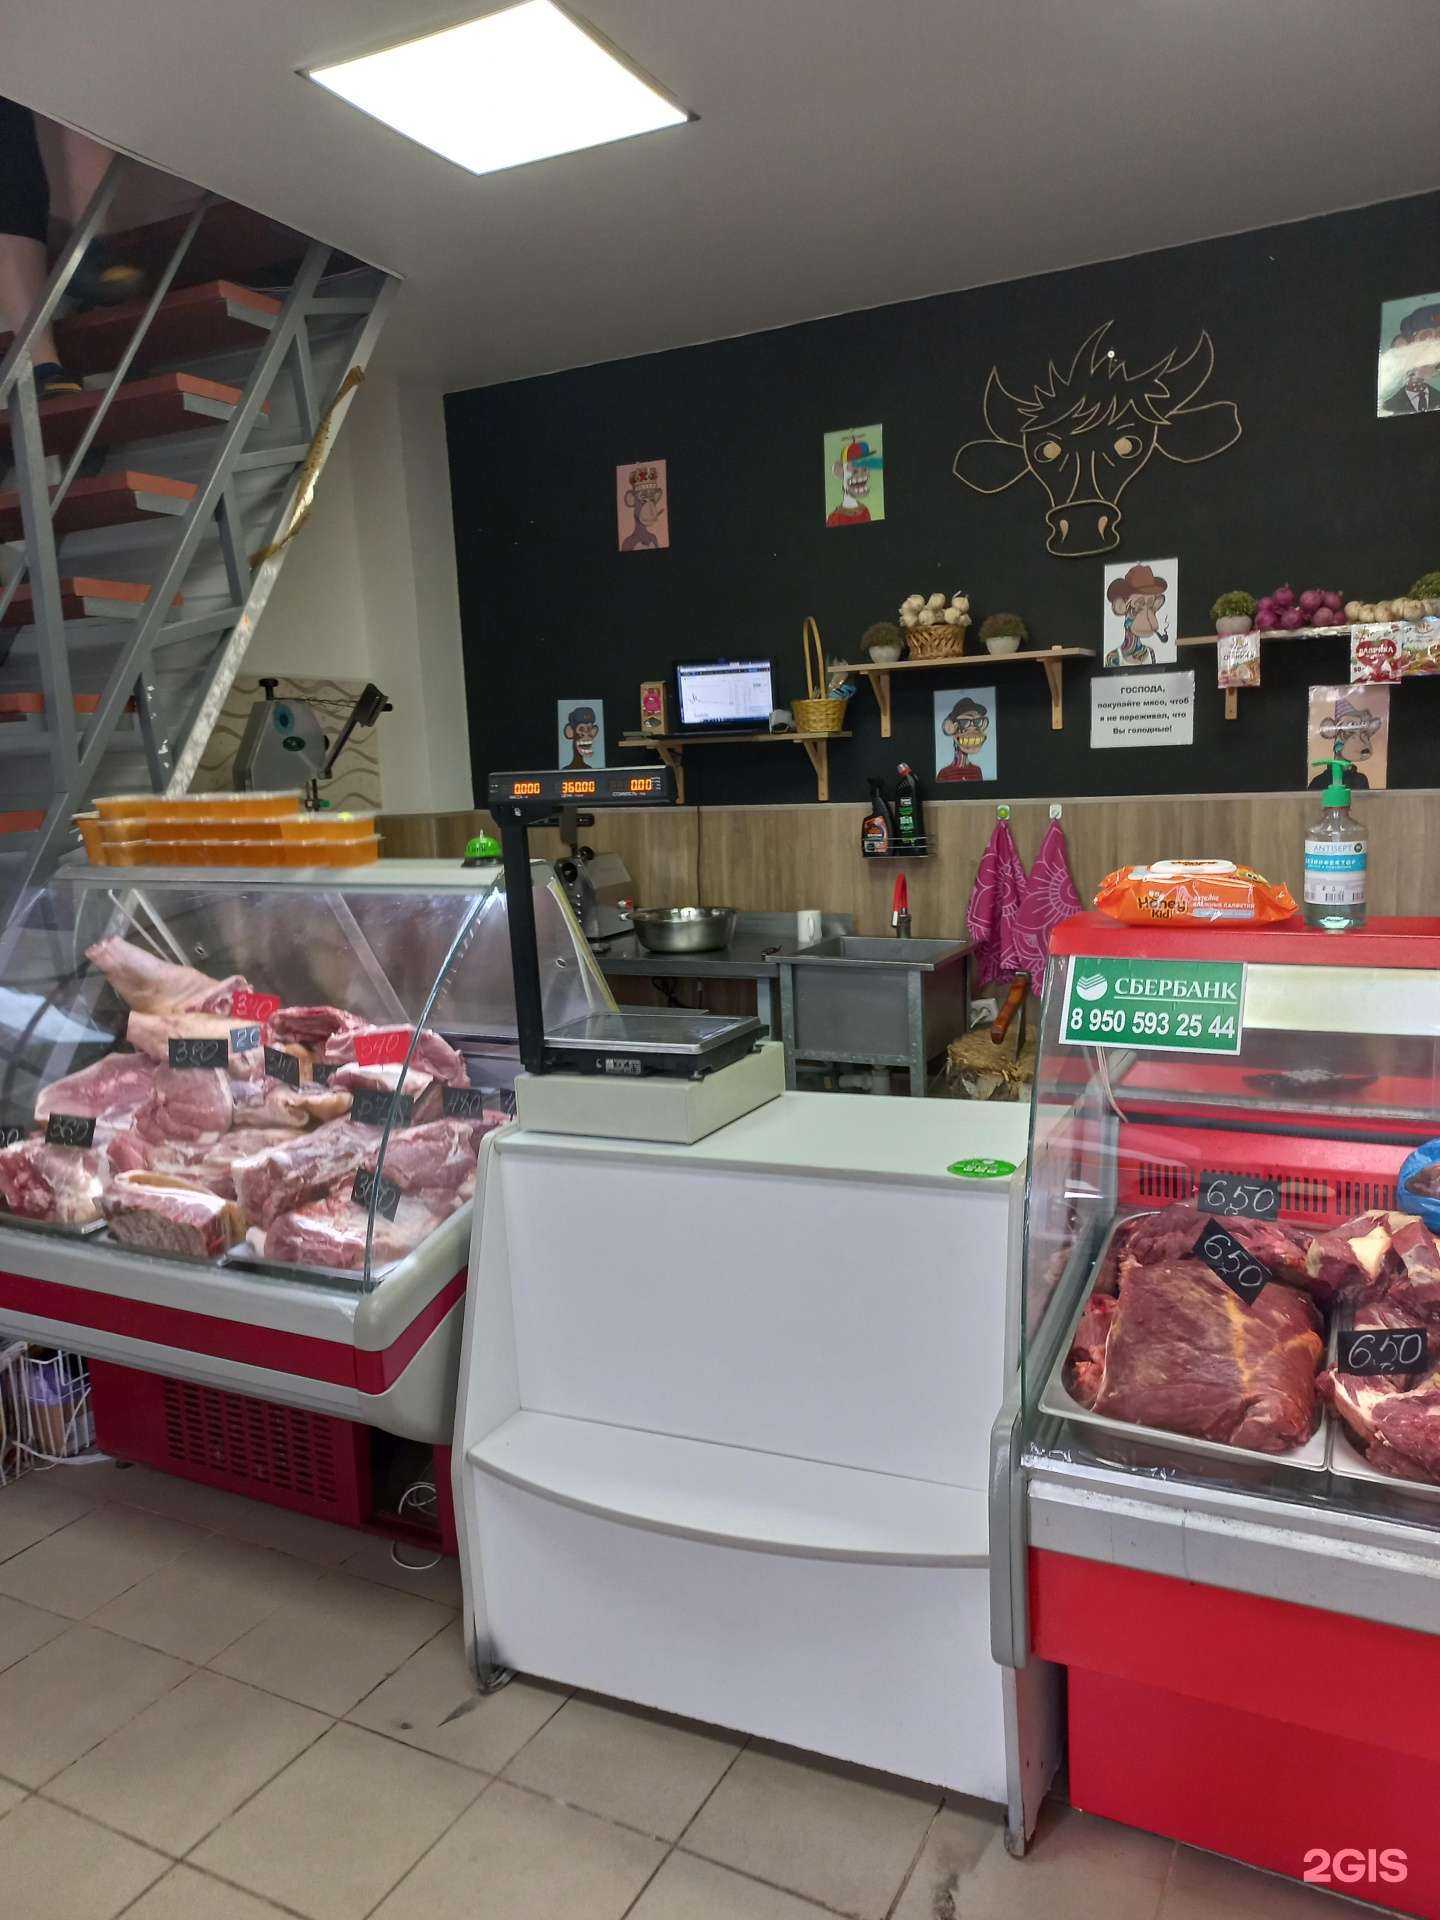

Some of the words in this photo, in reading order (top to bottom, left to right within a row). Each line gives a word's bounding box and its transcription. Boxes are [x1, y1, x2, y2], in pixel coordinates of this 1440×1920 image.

[1120, 685, 1166, 695] ГОСПОДА,
[1097, 701, 1141, 710] покупайте
[1169, 697, 1190, 705] чтоб
[1113, 727, 1126, 735] Вы
[1127, 725, 1173, 734] голодные!
[1138, 897, 1186, 912] Honey
[1151, 909, 1170, 919] Kid
[1114, 977, 1238, 1000] СБЕРБАНК
[1070, 1007, 1083, 1030] 8
[1089, 1008, 1126, 1033] 950
[1131, 1011, 1170, 1036] 593
[1176, 1013, 1203, 1038] 25
[1208, 1015, 1235, 1039] 44
[1206, 1179, 1275, 1213] 650
[1203, 1233, 1264, 1288] 650
[1348, 1333, 1423, 1369] 650
